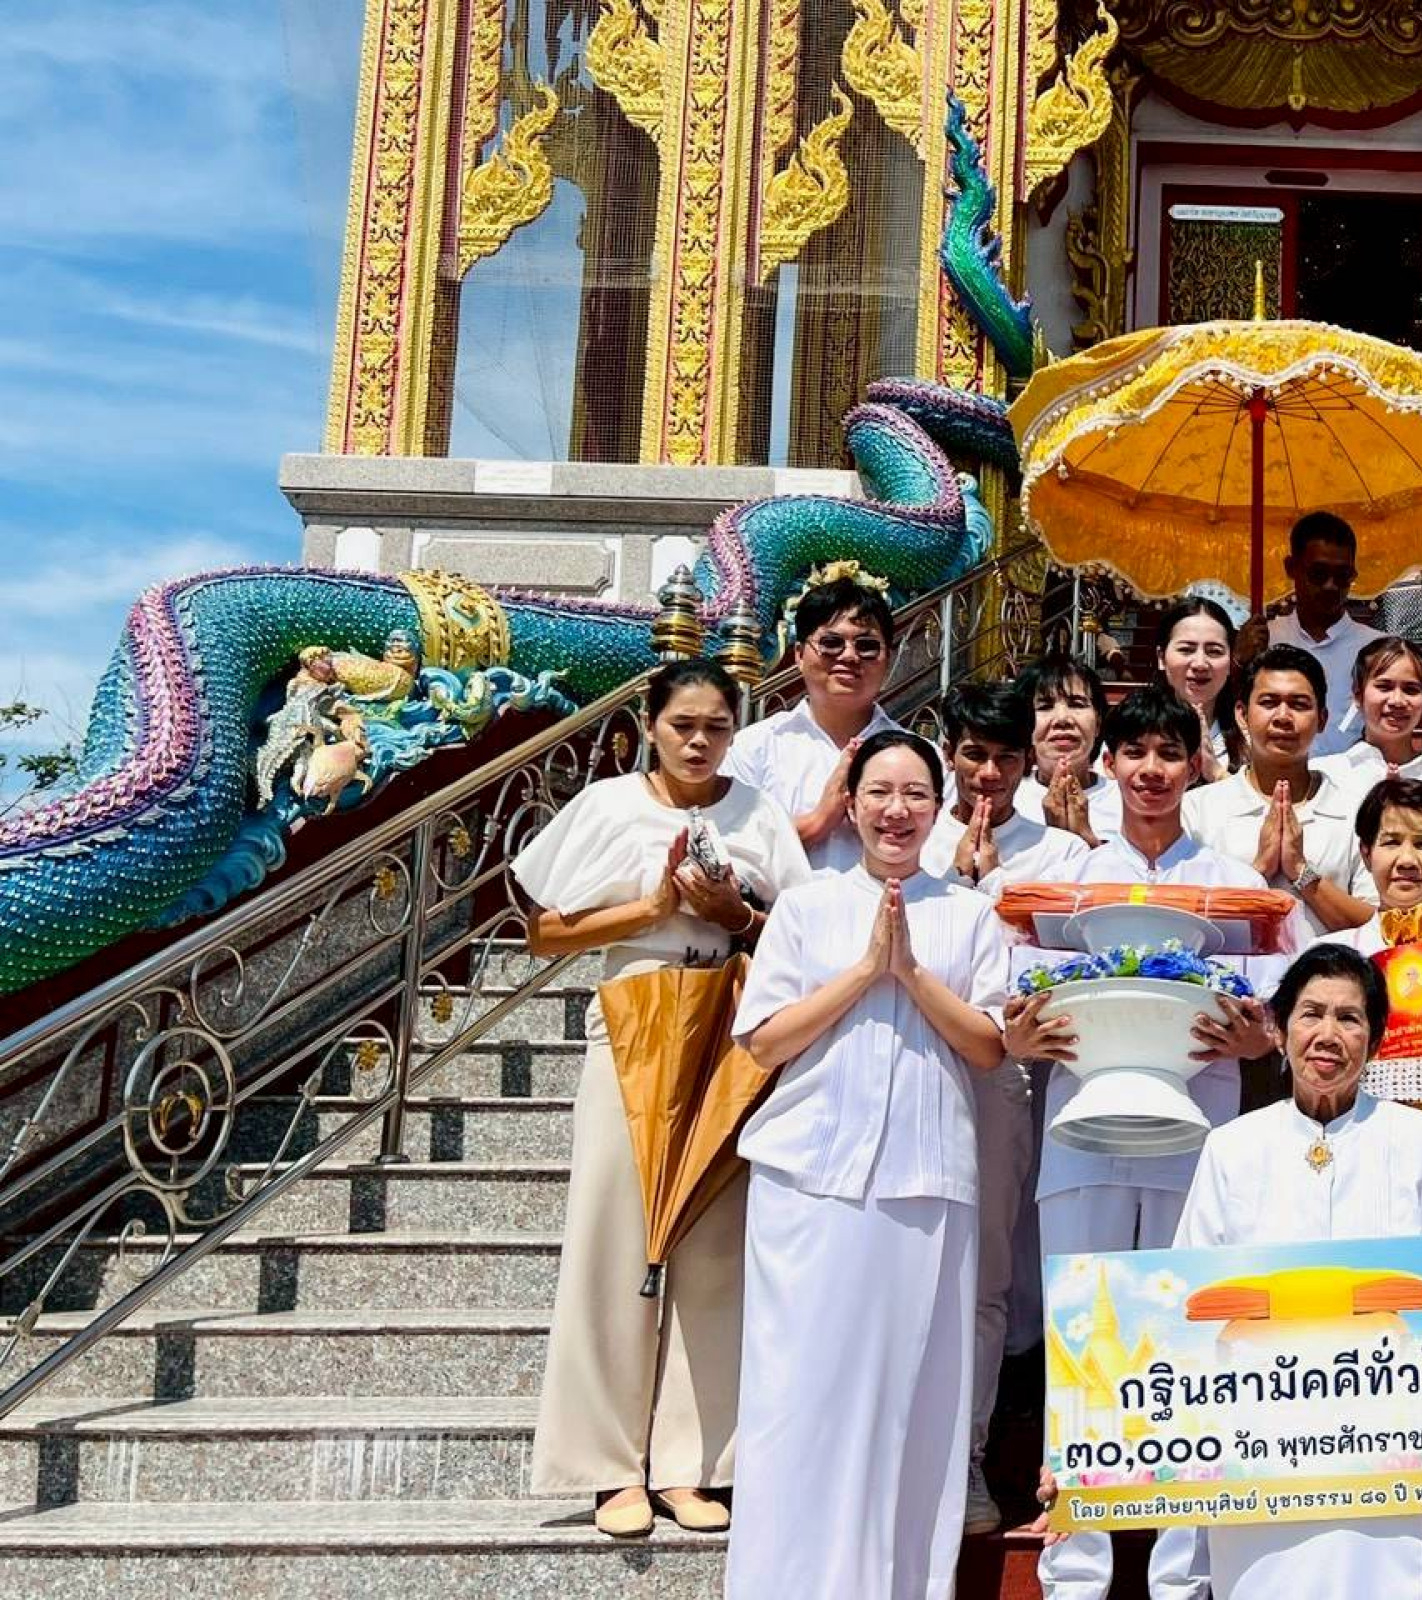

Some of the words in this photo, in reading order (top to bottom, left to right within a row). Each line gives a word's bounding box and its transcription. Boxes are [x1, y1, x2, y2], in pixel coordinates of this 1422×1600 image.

[1066, 1436, 1222, 1472] ๓๐,๐๐๐
[1234, 1431, 1268, 1460] วัด
[1070, 1499, 1106, 1519] โดย
[1112, 1489, 1258, 1518] คณะศิษยานุศิษย์
[1265, 1490, 1354, 1516] บูชาธรรม
[1360, 1490, 1387, 1506] ๘๑
[1393, 1481, 1407, 1503] ปี
